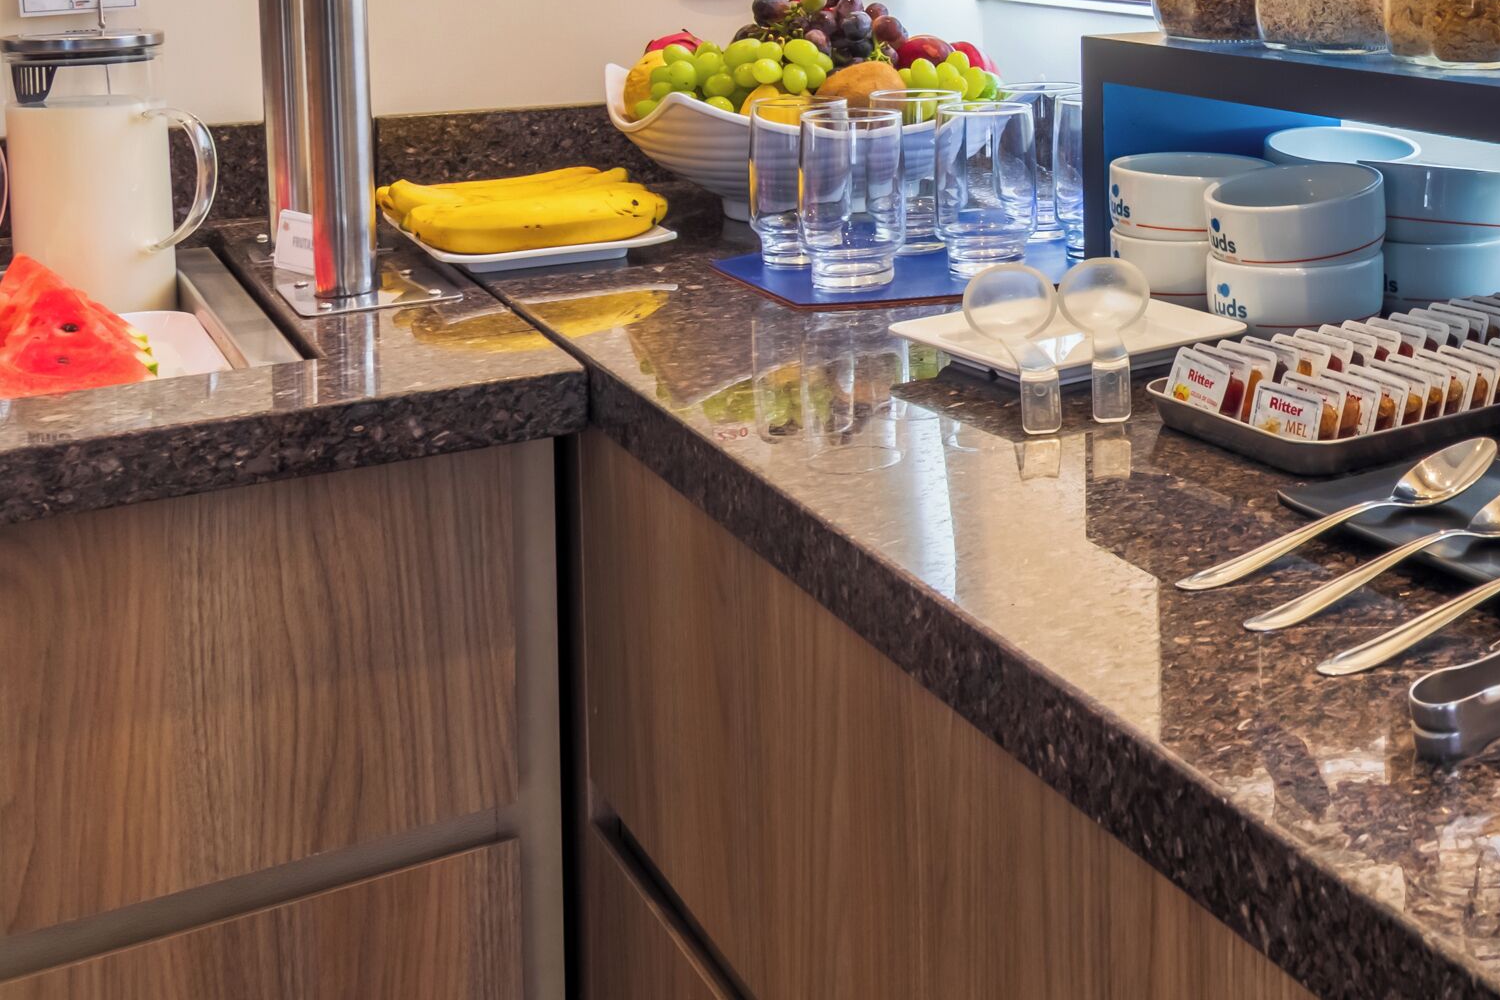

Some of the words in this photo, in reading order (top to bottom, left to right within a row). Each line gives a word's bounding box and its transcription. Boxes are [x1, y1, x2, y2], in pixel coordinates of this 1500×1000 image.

[1111, 198, 1131, 218] uds
[1214, 293, 1248, 319] luds
[1187, 368, 1215, 390] Ritter
[1269, 396, 1304, 418] Ritter
[1285, 419, 1308, 439] MEL
